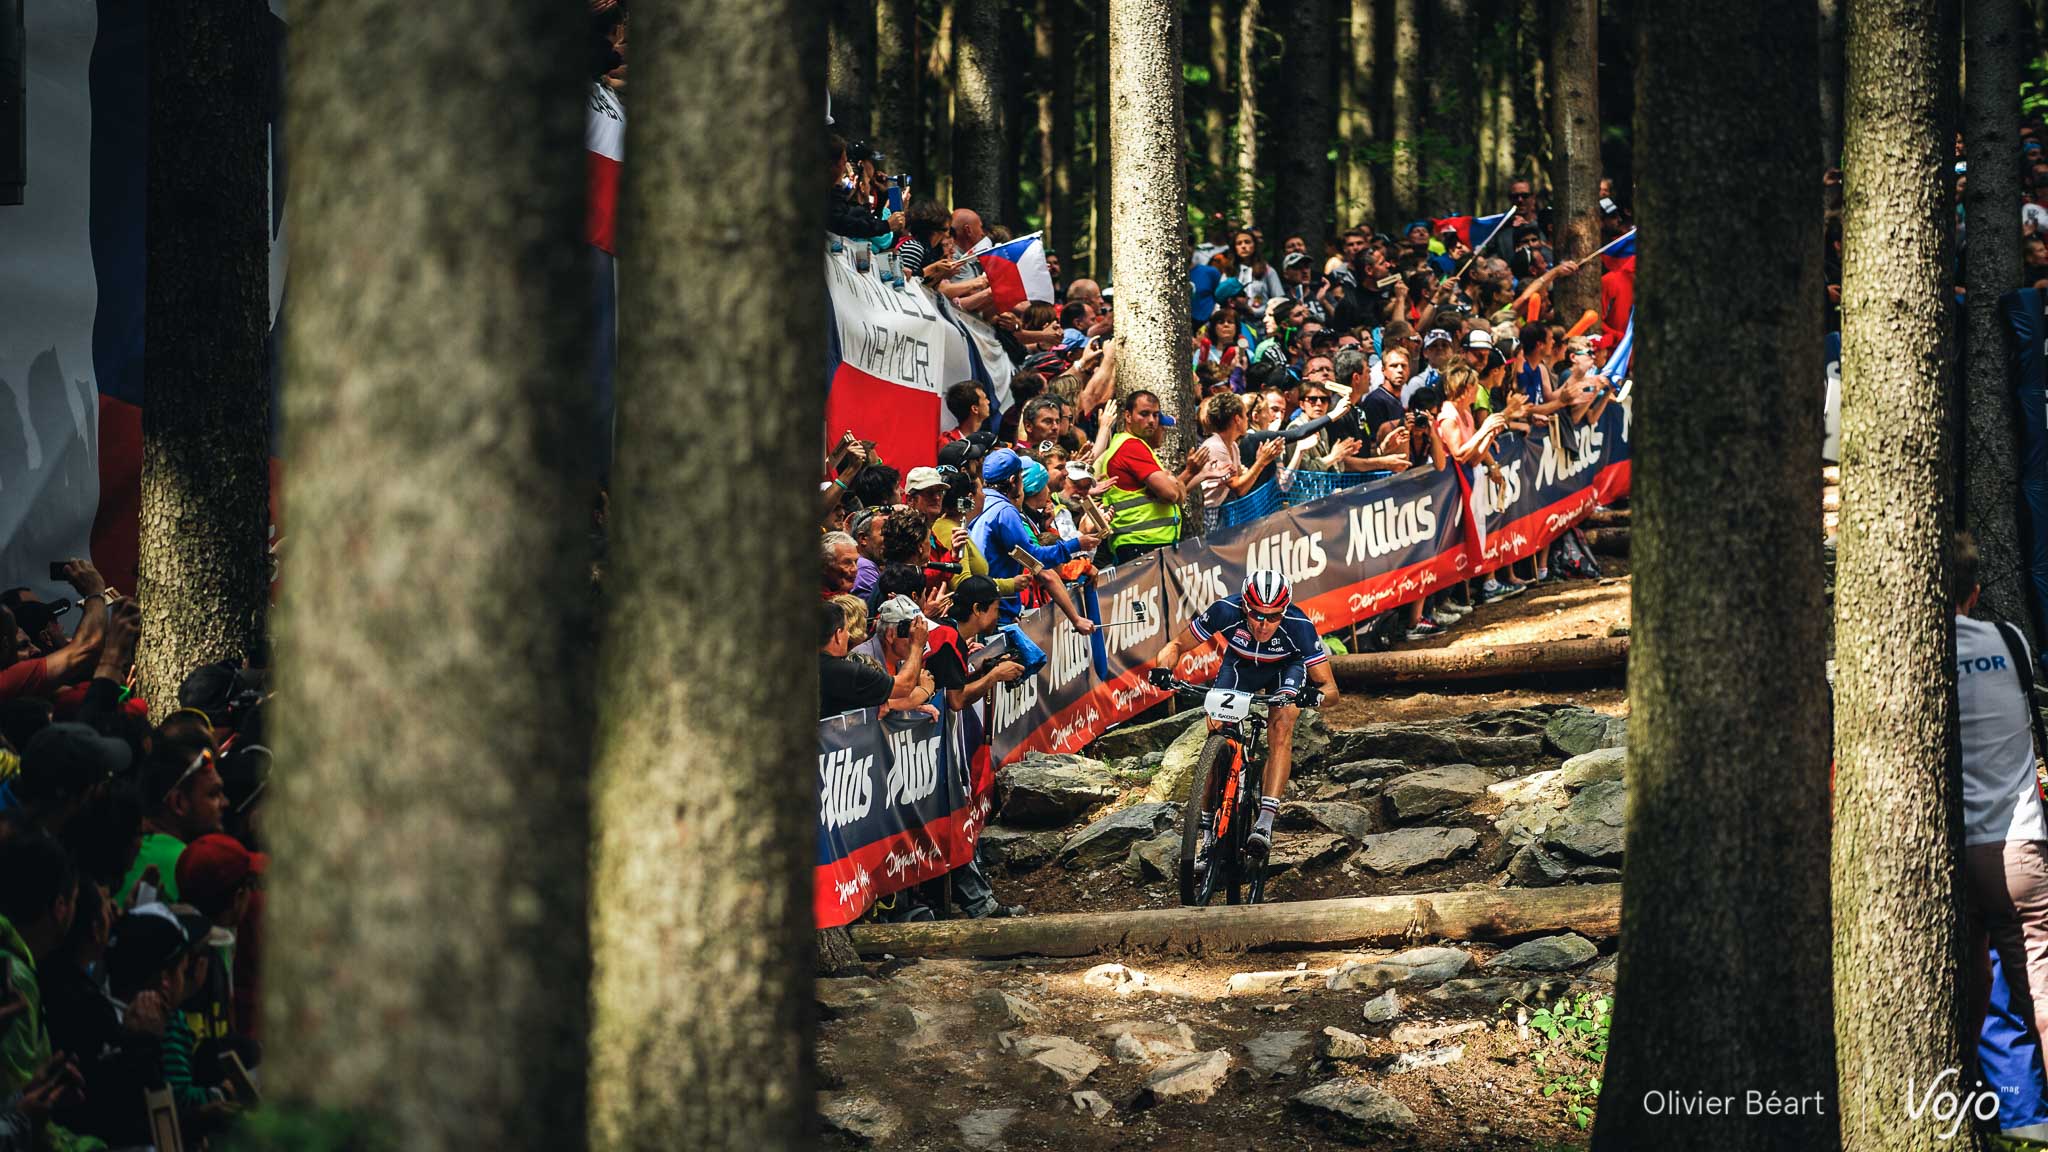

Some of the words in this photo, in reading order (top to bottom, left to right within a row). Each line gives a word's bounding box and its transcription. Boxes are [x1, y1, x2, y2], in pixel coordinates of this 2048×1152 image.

[1345, 495, 1437, 566] Mitas
[1246, 531, 1328, 585] Mitas
[1105, 584, 1161, 656] Mitas
[1956, 655, 2007, 675] TOR
[1220, 692, 1236, 709] 2
